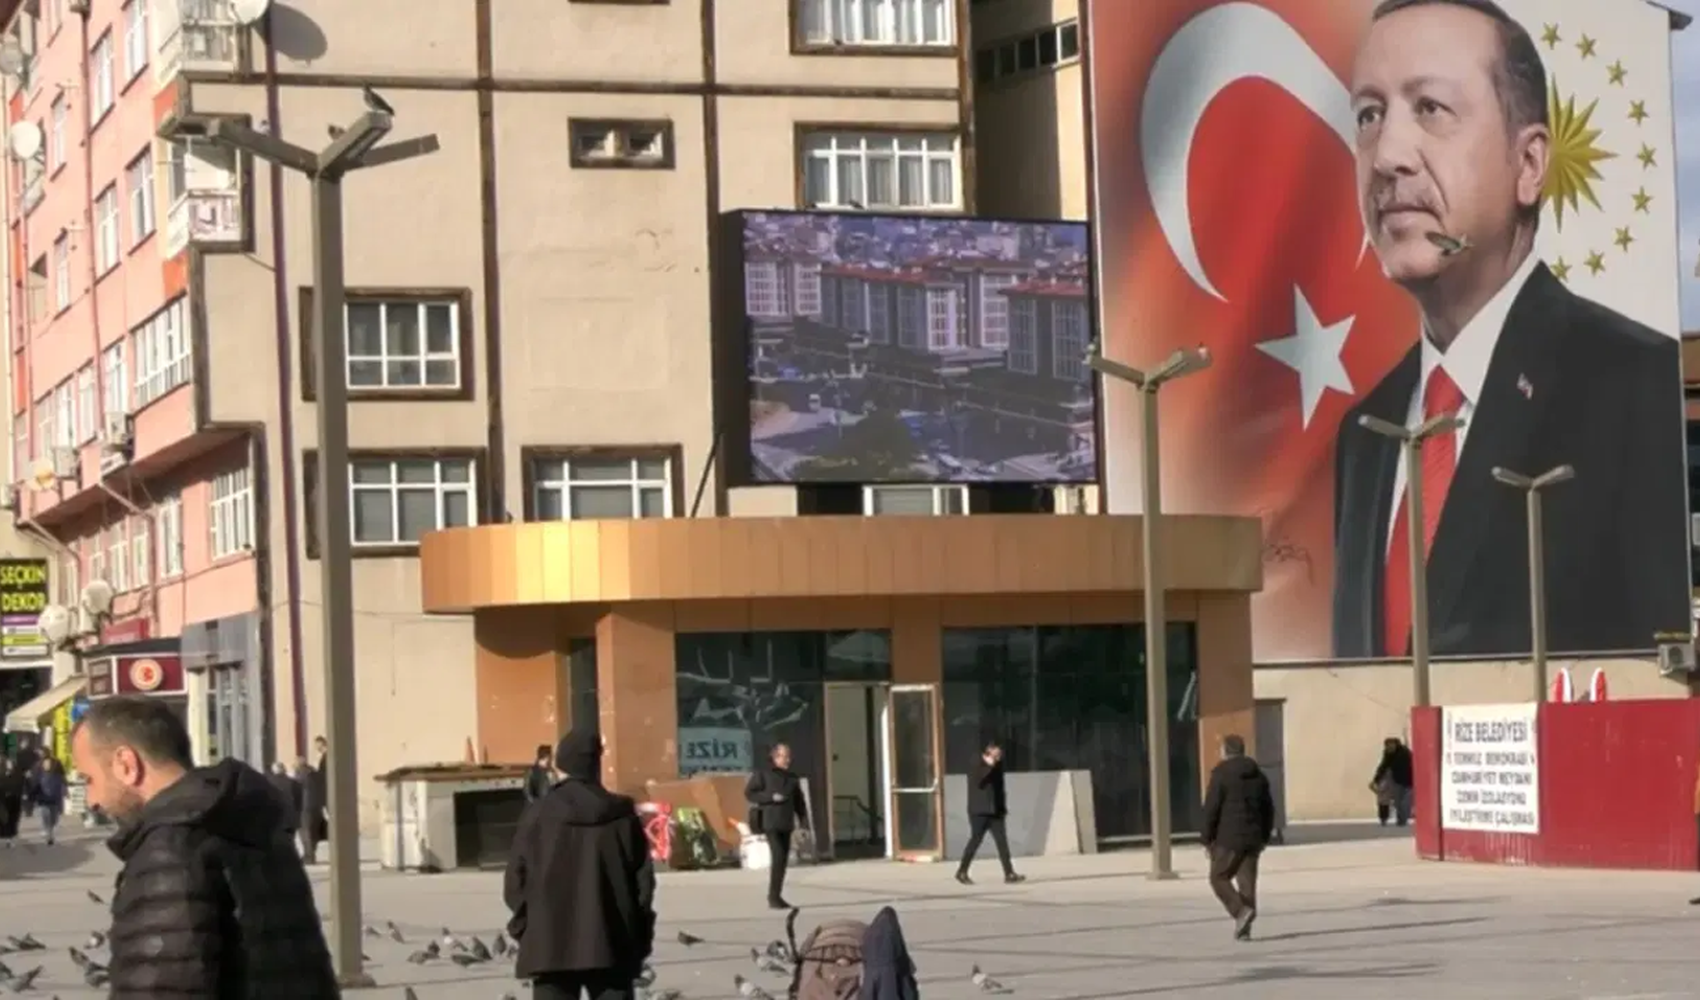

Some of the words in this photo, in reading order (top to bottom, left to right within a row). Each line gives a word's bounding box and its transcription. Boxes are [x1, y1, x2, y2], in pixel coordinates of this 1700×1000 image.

[2, 592, 46, 611] DEKOR
[1455, 718, 1473, 742] RİZE
[1475, 717, 1528, 742] BELEDİYESİ
